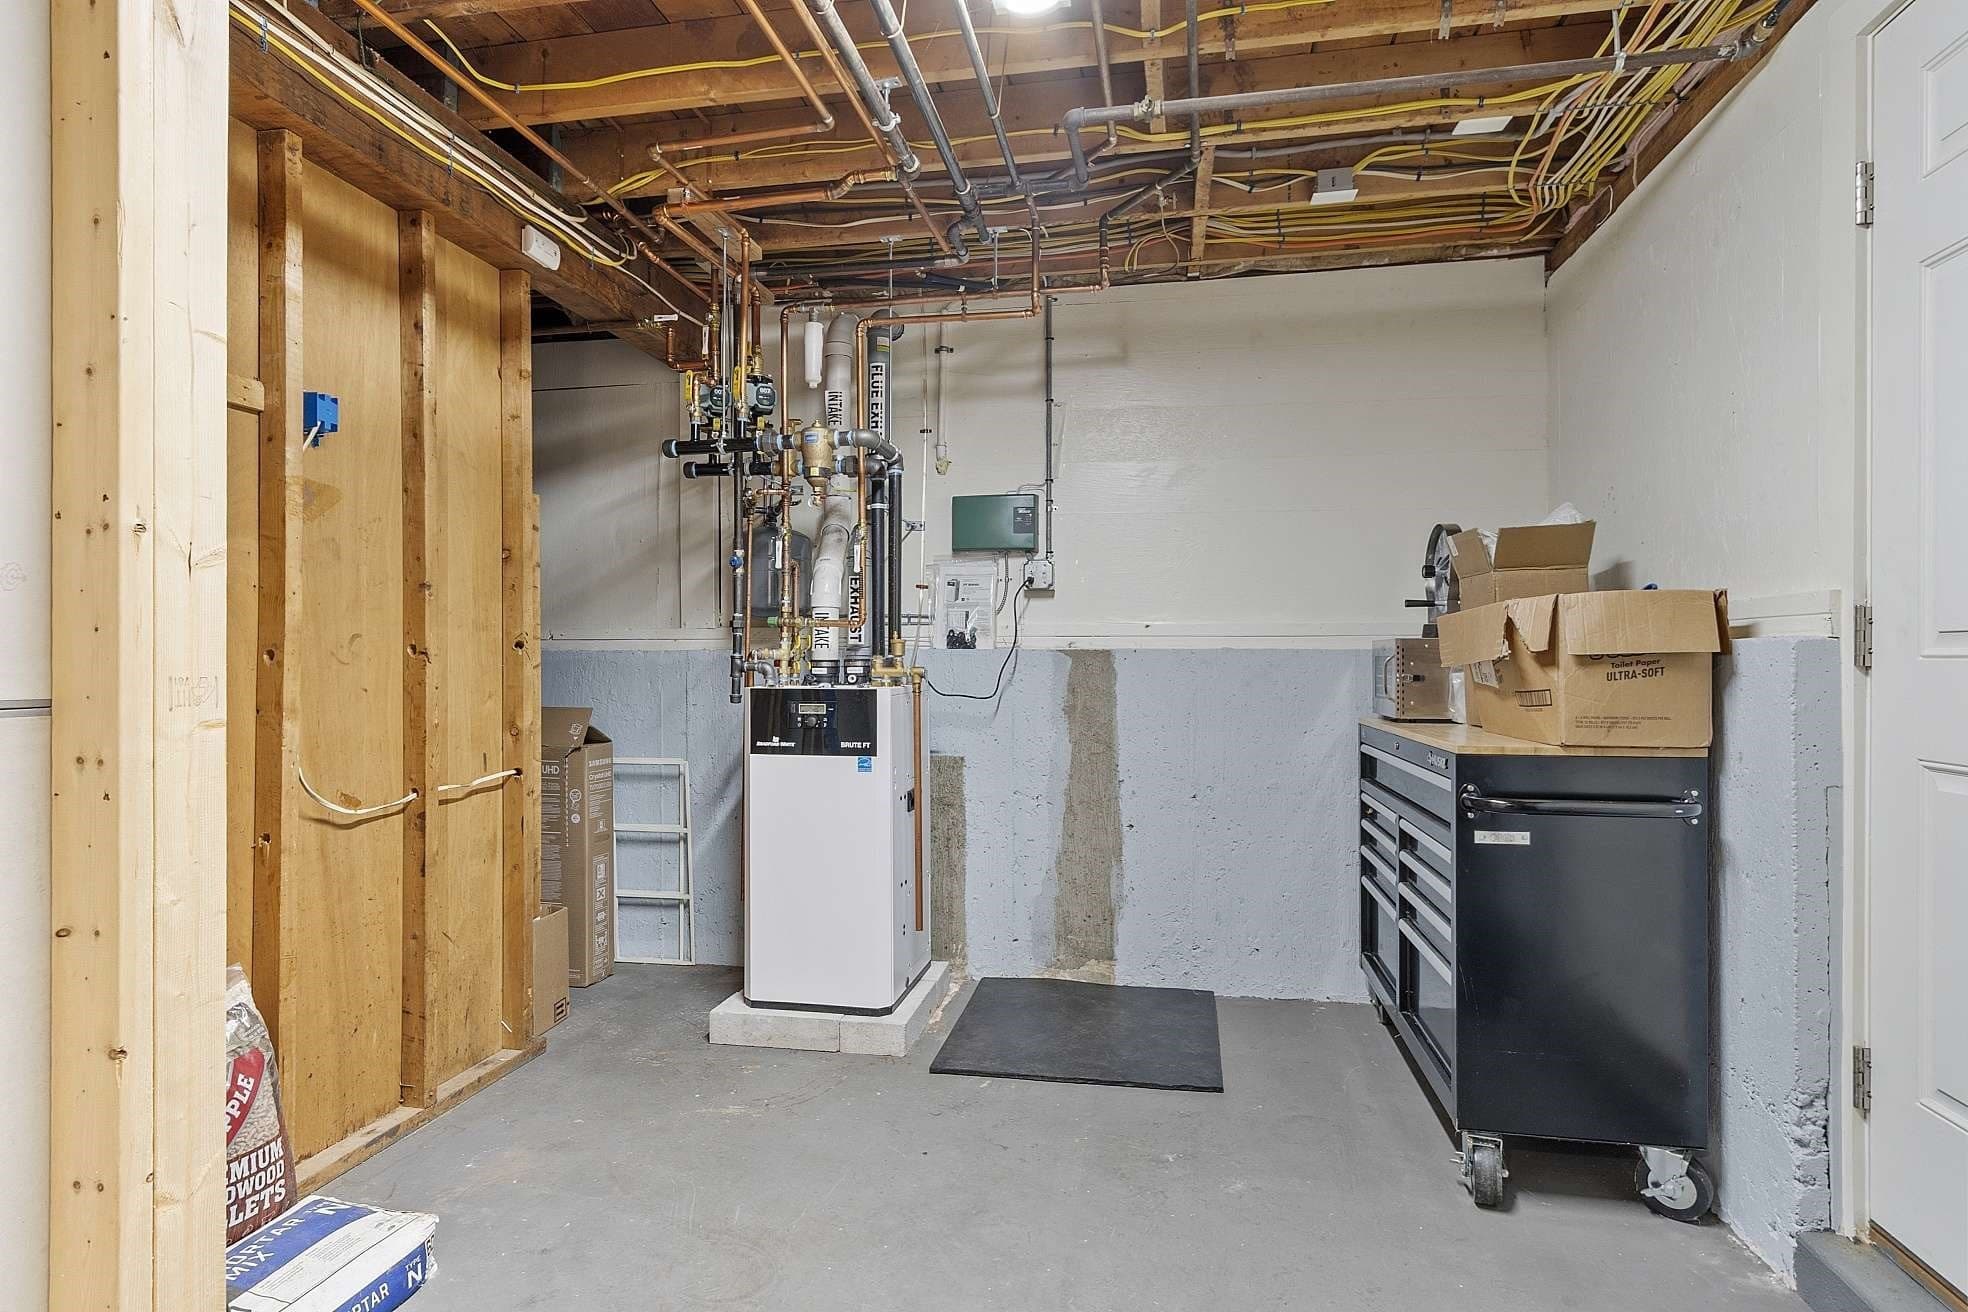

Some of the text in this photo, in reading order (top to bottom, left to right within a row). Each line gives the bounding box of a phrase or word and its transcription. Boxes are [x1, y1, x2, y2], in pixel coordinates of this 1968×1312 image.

[827, 391, 842, 426] INTAKE
[870, 365, 883, 436] FLUE EXH
[849, 577, 862, 643] EXHAUST
[814, 612, 830, 649] INAKE
[1606, 666, 1665, 681] ULTRA-SOFT
[1611, 659, 1661, 669] Toilet Paper
[862, 741, 871, 749] FT
[542, 765, 560, 775] UHD
[226, 1136, 283, 1184] MIUM
[226, 1178, 286, 1227] LETS
[226, 1218, 305, 1266] ORTAR
[407, 1262, 423, 1289] N
[346, 1283, 390, 1312] RTAR
